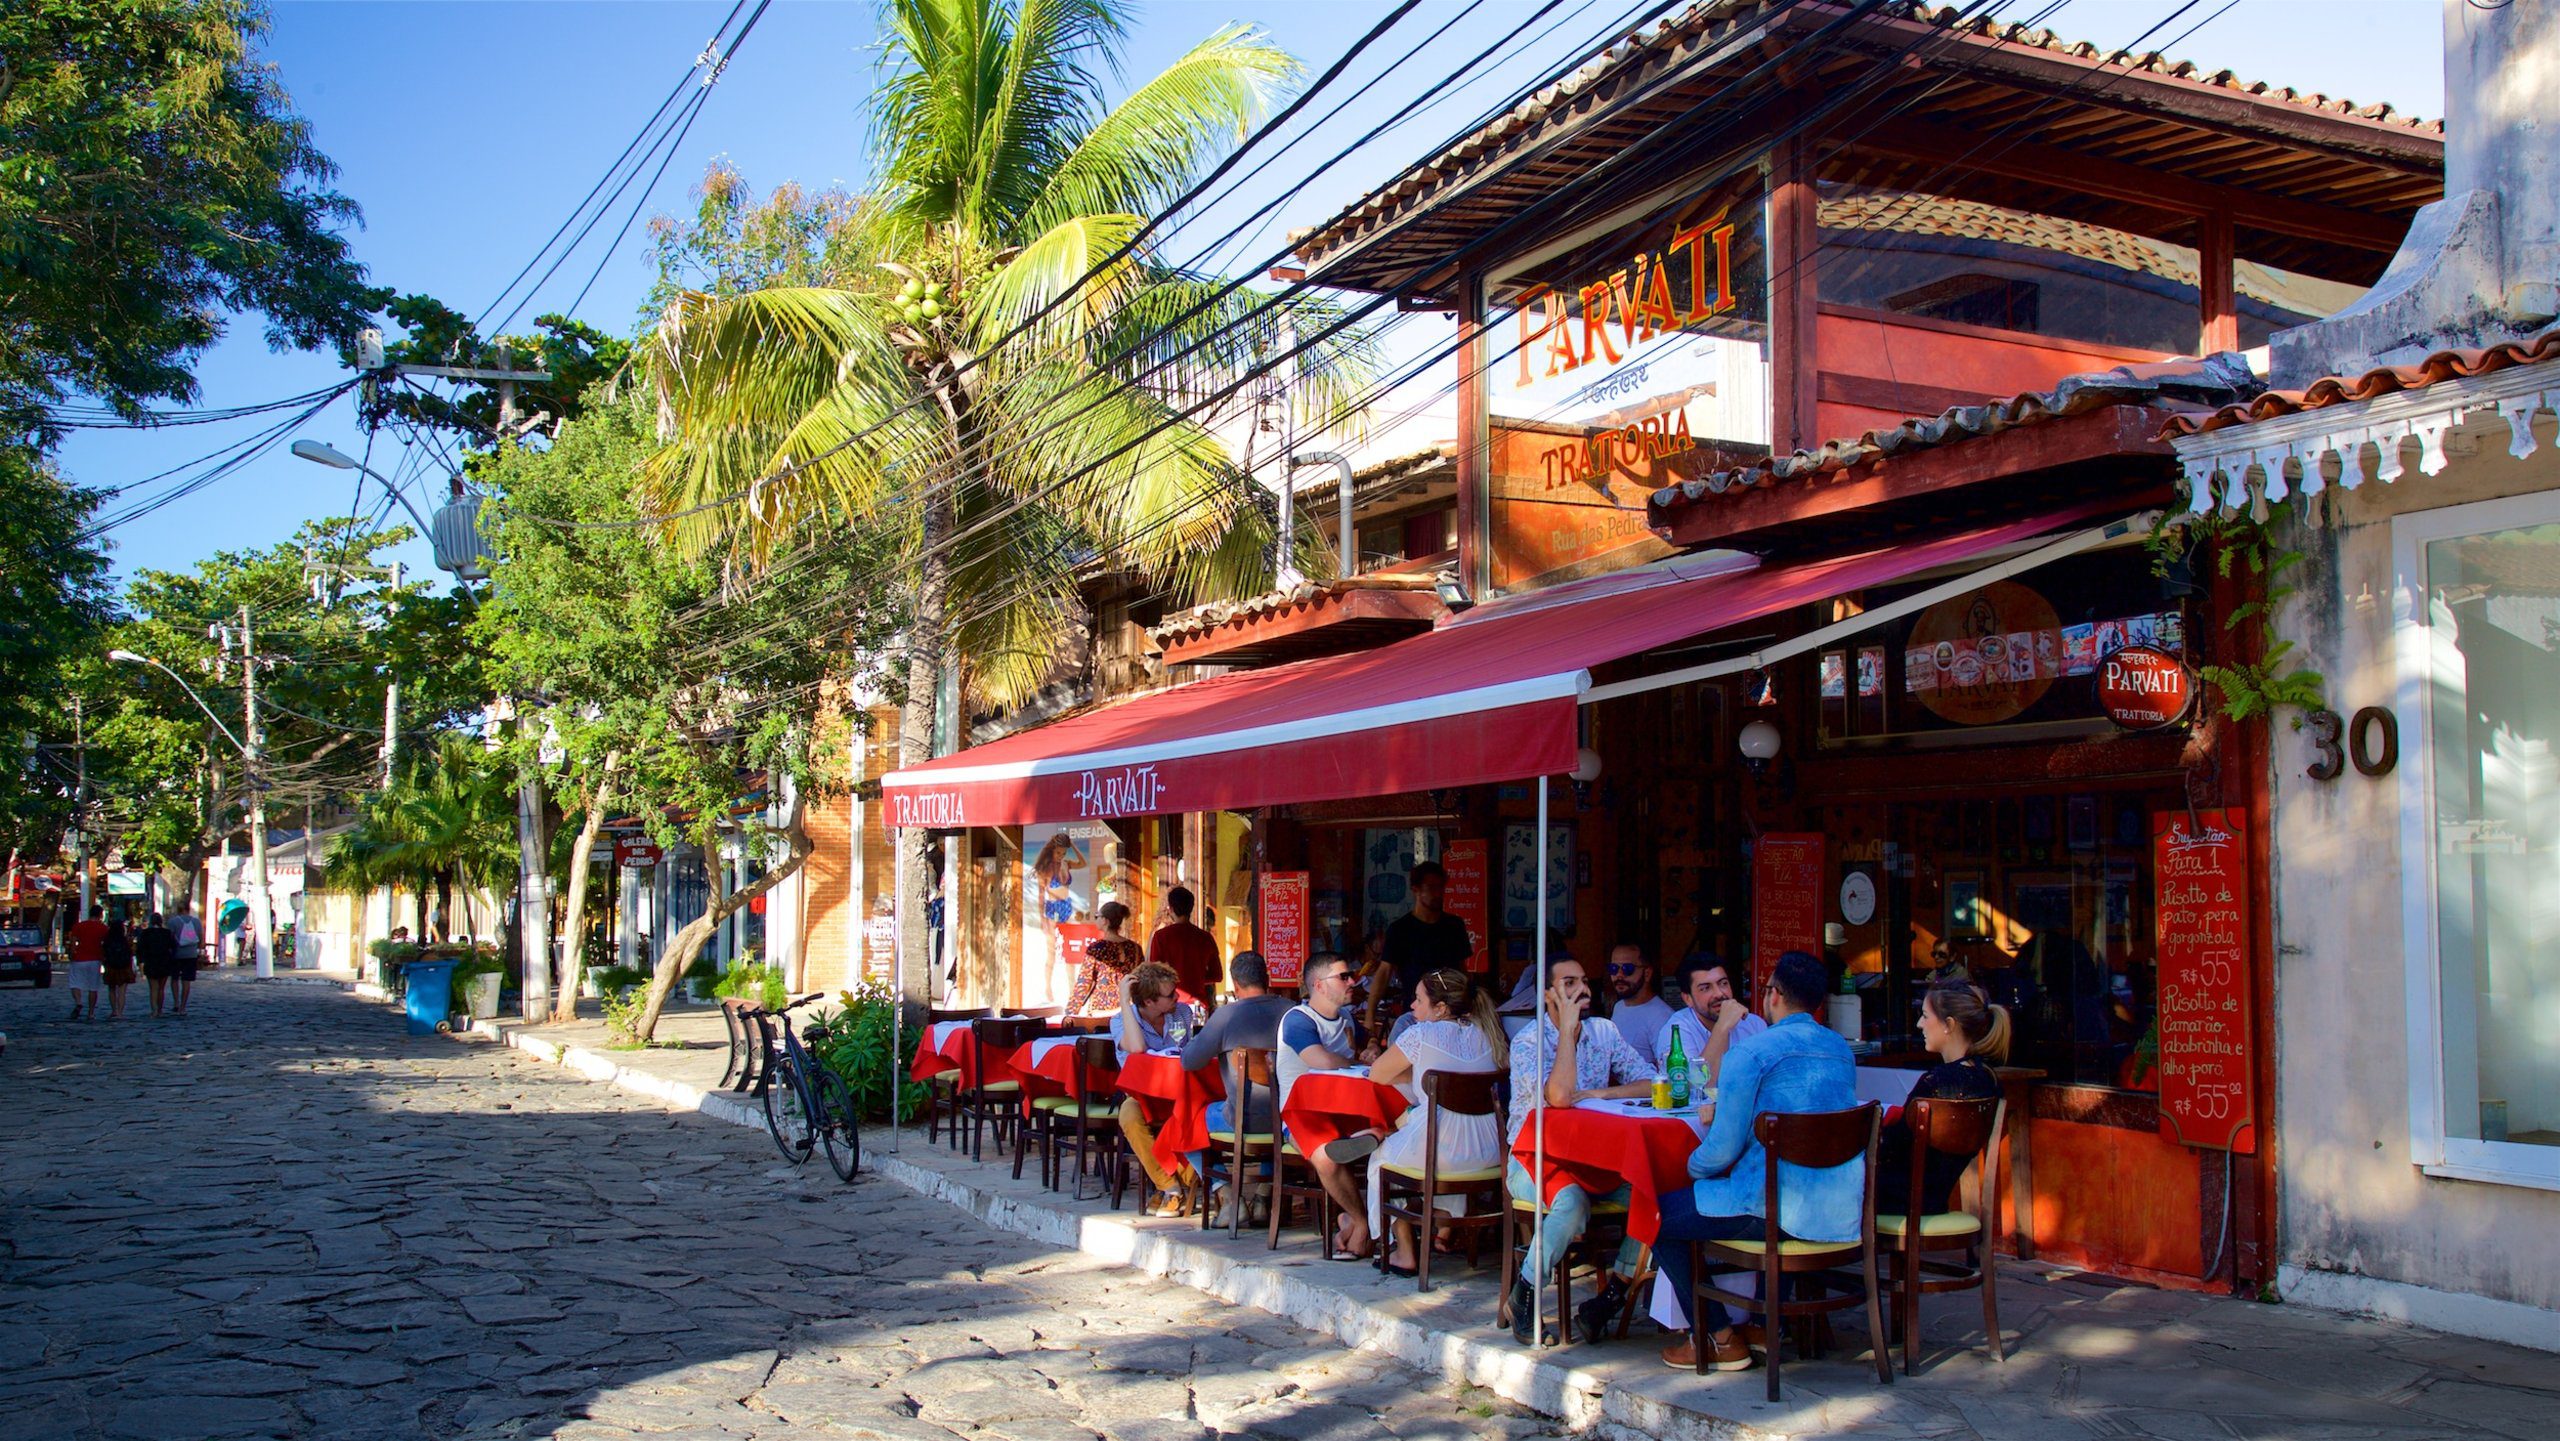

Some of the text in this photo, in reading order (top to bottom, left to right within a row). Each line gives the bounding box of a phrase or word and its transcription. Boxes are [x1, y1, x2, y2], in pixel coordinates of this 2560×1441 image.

[1516, 205, 1736, 388] PARVATI
[1540, 406, 1696, 491] TRATTORIA
[1552, 512, 1650, 553] Rua das Pedra
[2106, 662, 2178, 696] PARVATI
[2114, 708, 2165, 722] TRATTORIA
[2306, 706, 2398, 781] 30
[1080, 764, 1158, 818] PARVATI
[893, 791, 966, 827] TRATTORIA
[1069, 827, 1112, 840] ENSEADA
[2163, 847, 2220, 873] Para 1
[2161, 881, 2234, 906] Risotto de
[2203, 910, 2240, 934] pera
[2168, 925, 2235, 957] gorgonzola
[2163, 984, 2238, 1014] Risotto de
[2164, 1035, 2243, 1056] abobrinha e
[2163, 1056, 2186, 1076] alho
